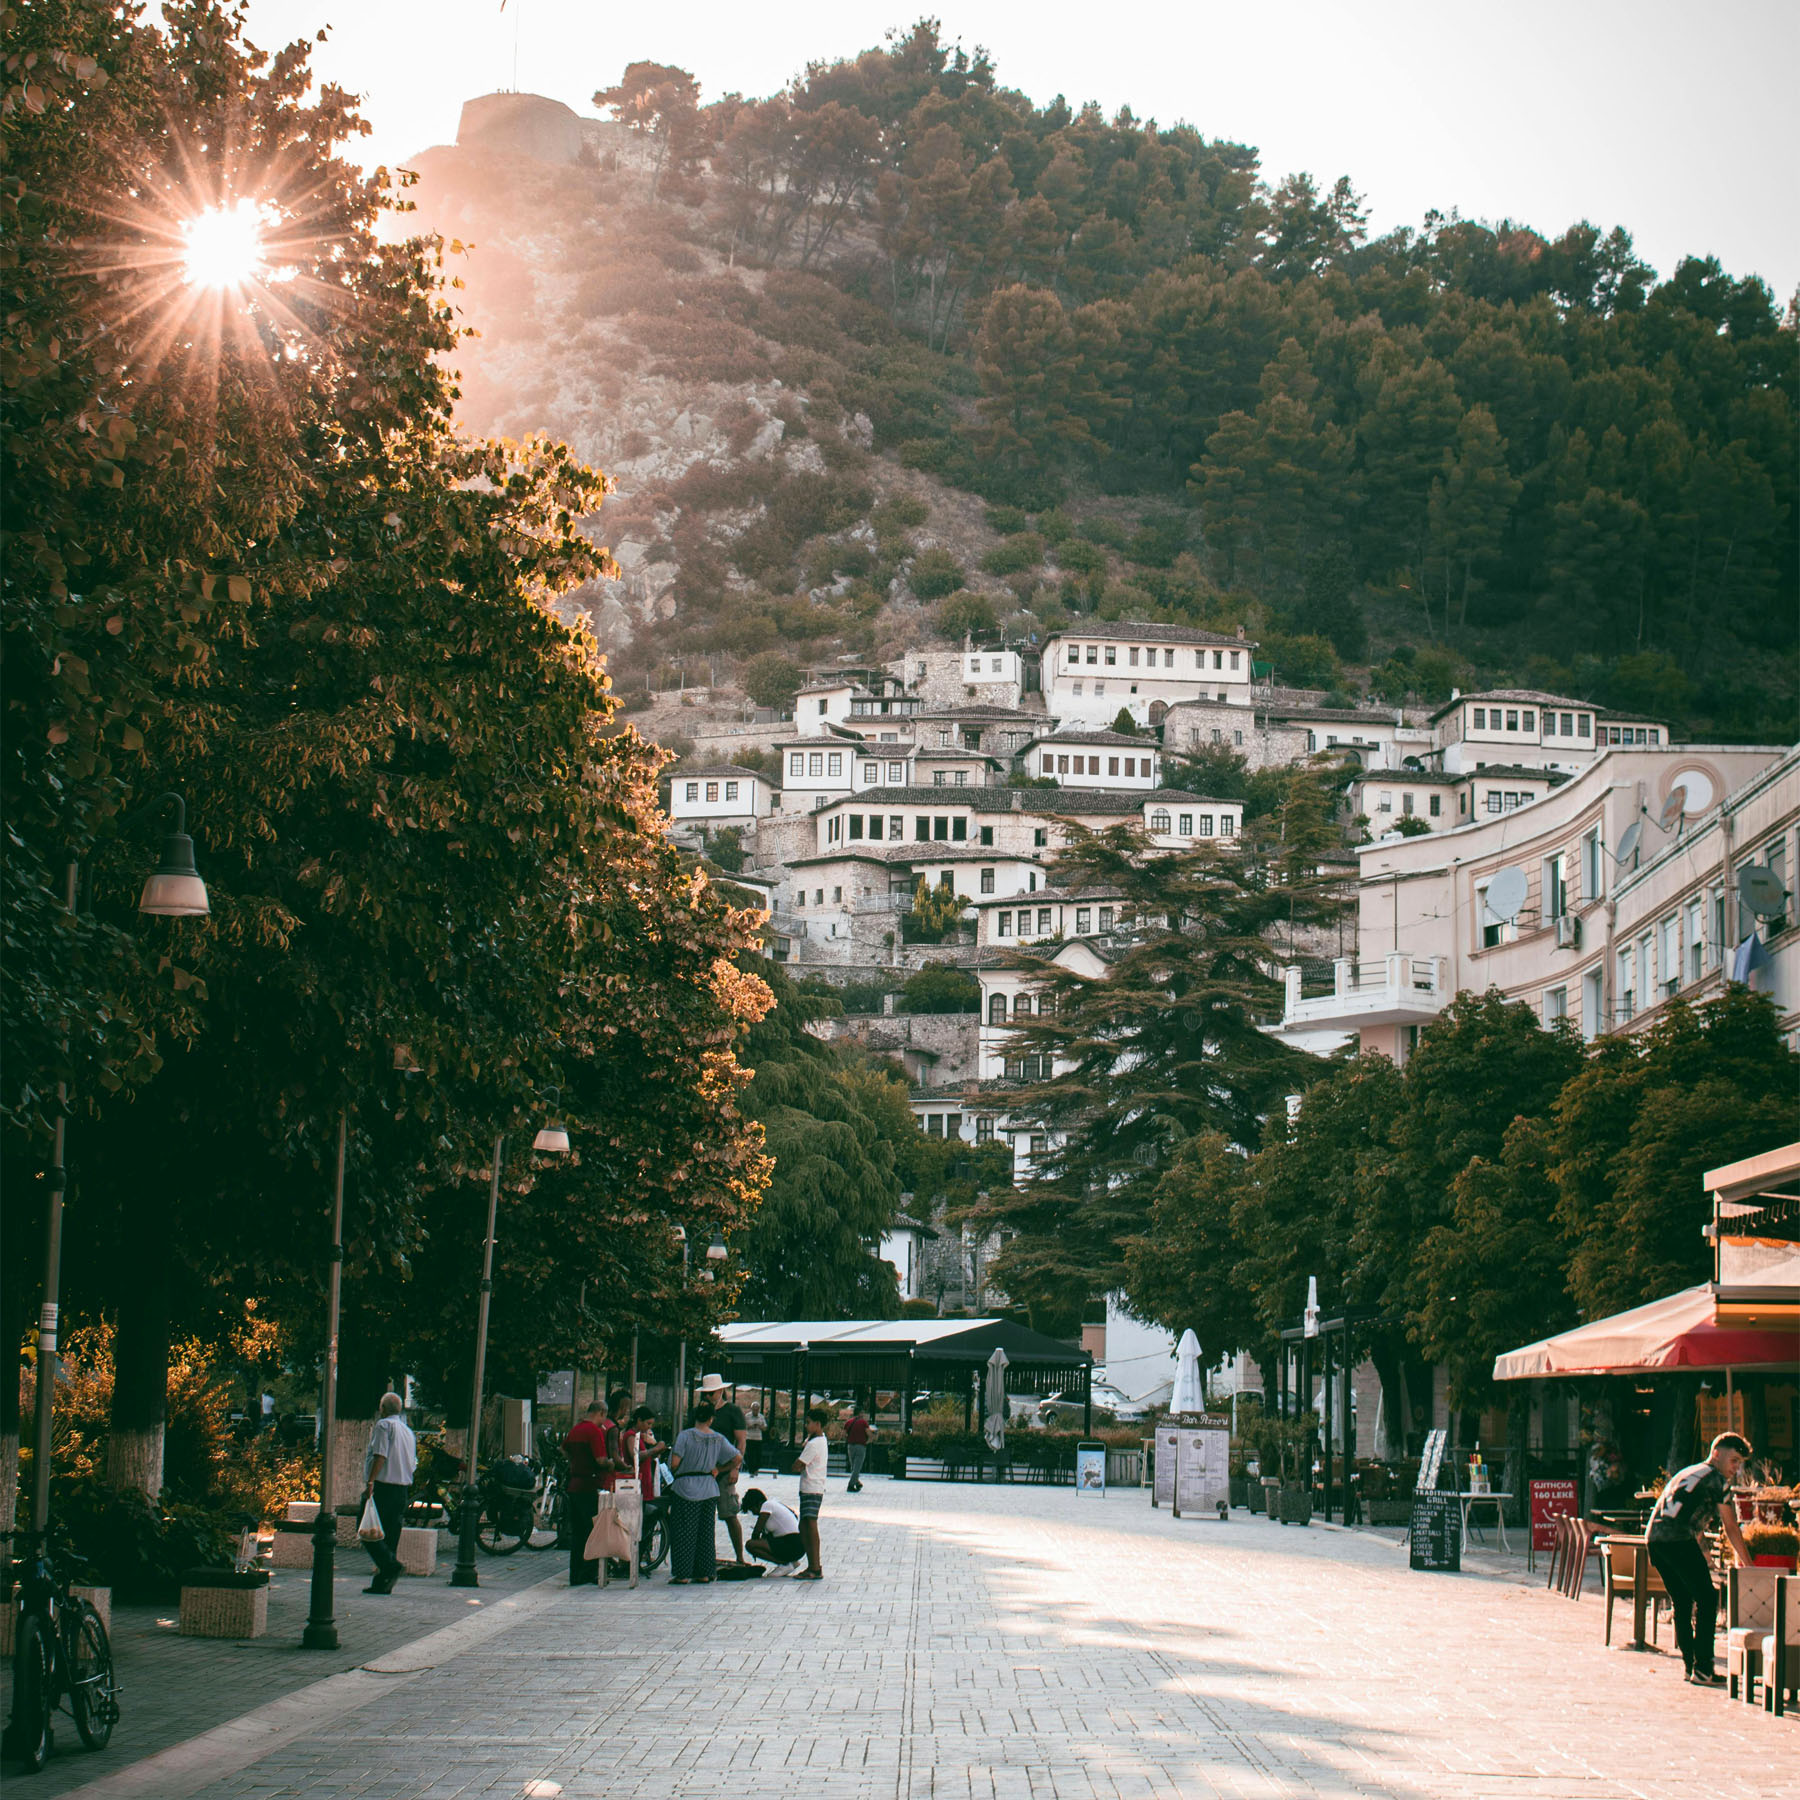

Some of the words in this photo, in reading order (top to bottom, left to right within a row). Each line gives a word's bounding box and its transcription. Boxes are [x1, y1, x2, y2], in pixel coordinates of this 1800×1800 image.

[1182, 1414, 1198, 1424] Bar
[1534, 1482, 1573, 1490] GJITHÇKA
[1534, 1491, 1550, 1499] 160
[1426, 1496, 1448, 1504] GRILL
